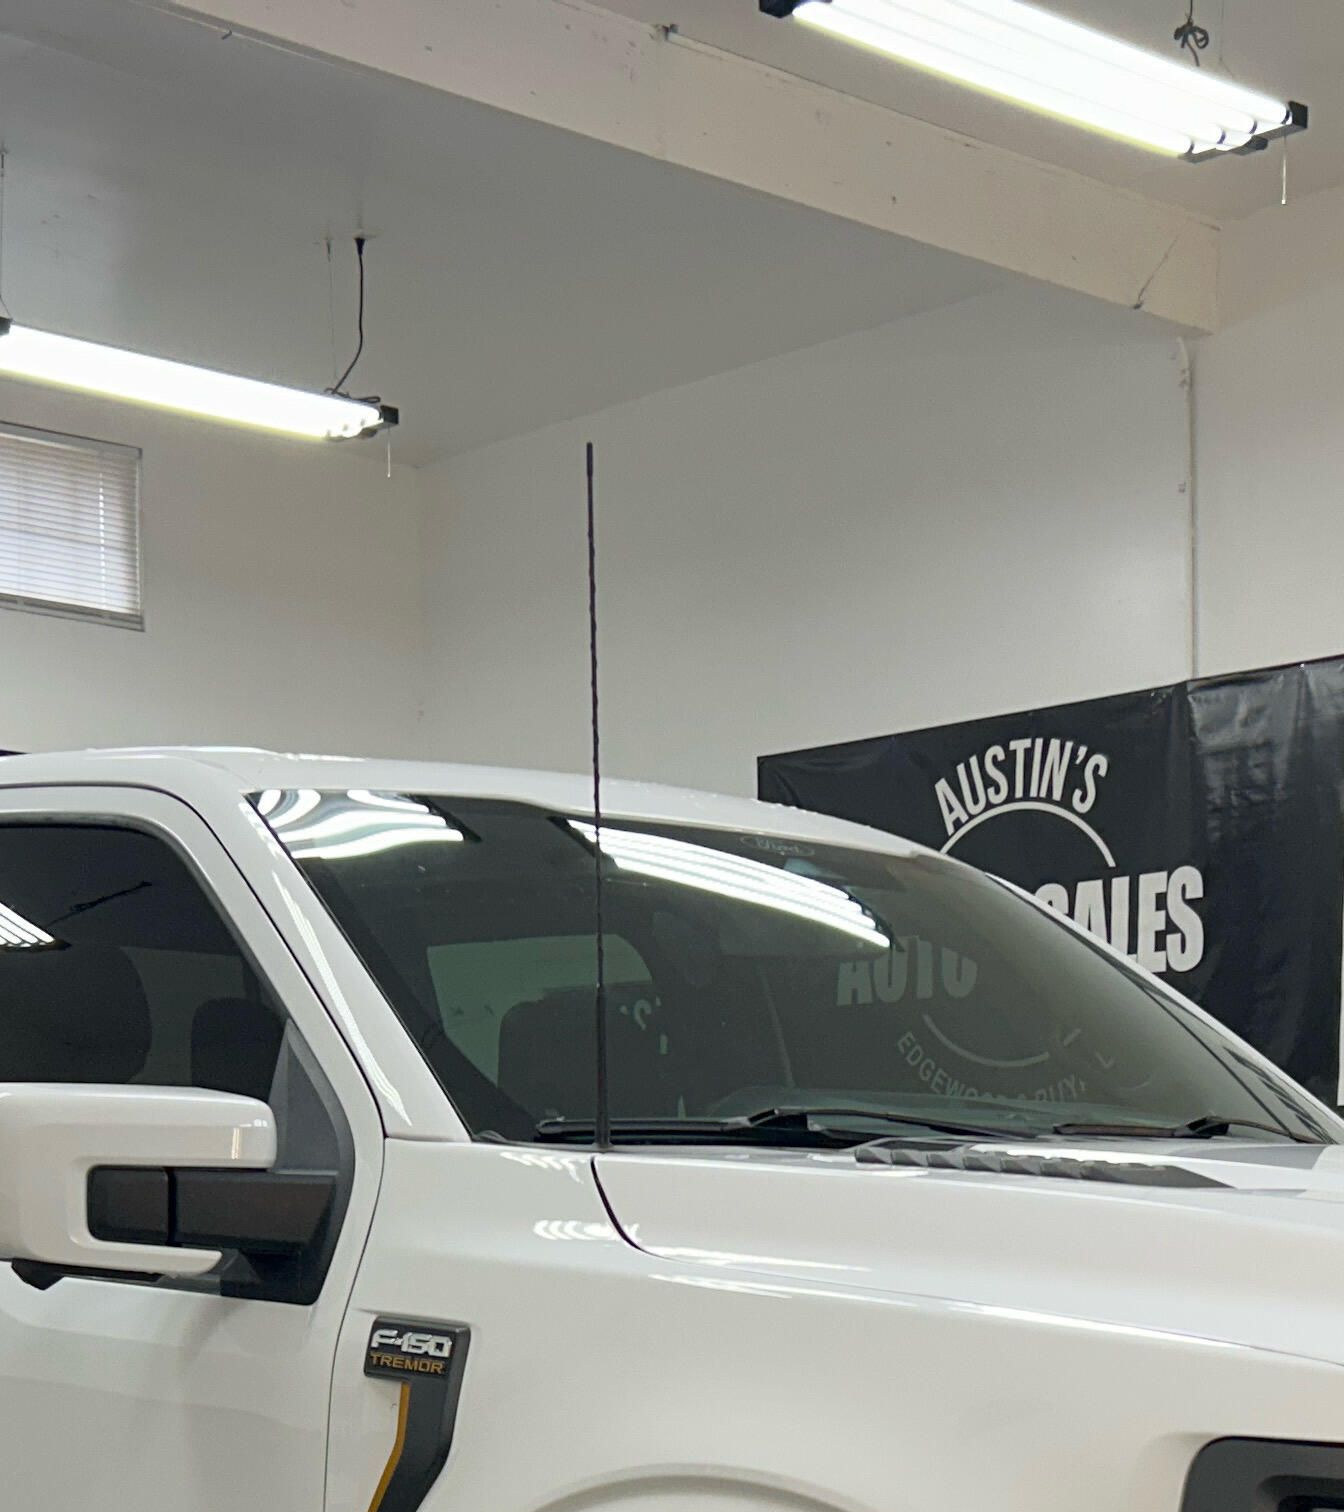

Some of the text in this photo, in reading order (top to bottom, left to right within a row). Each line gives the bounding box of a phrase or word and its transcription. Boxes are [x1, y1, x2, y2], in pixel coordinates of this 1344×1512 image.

[934, 737, 1108, 836] AUSTIN'S
[371, 1329, 452, 1357] F-150
[370, 1353, 444, 1375] TREMOR
